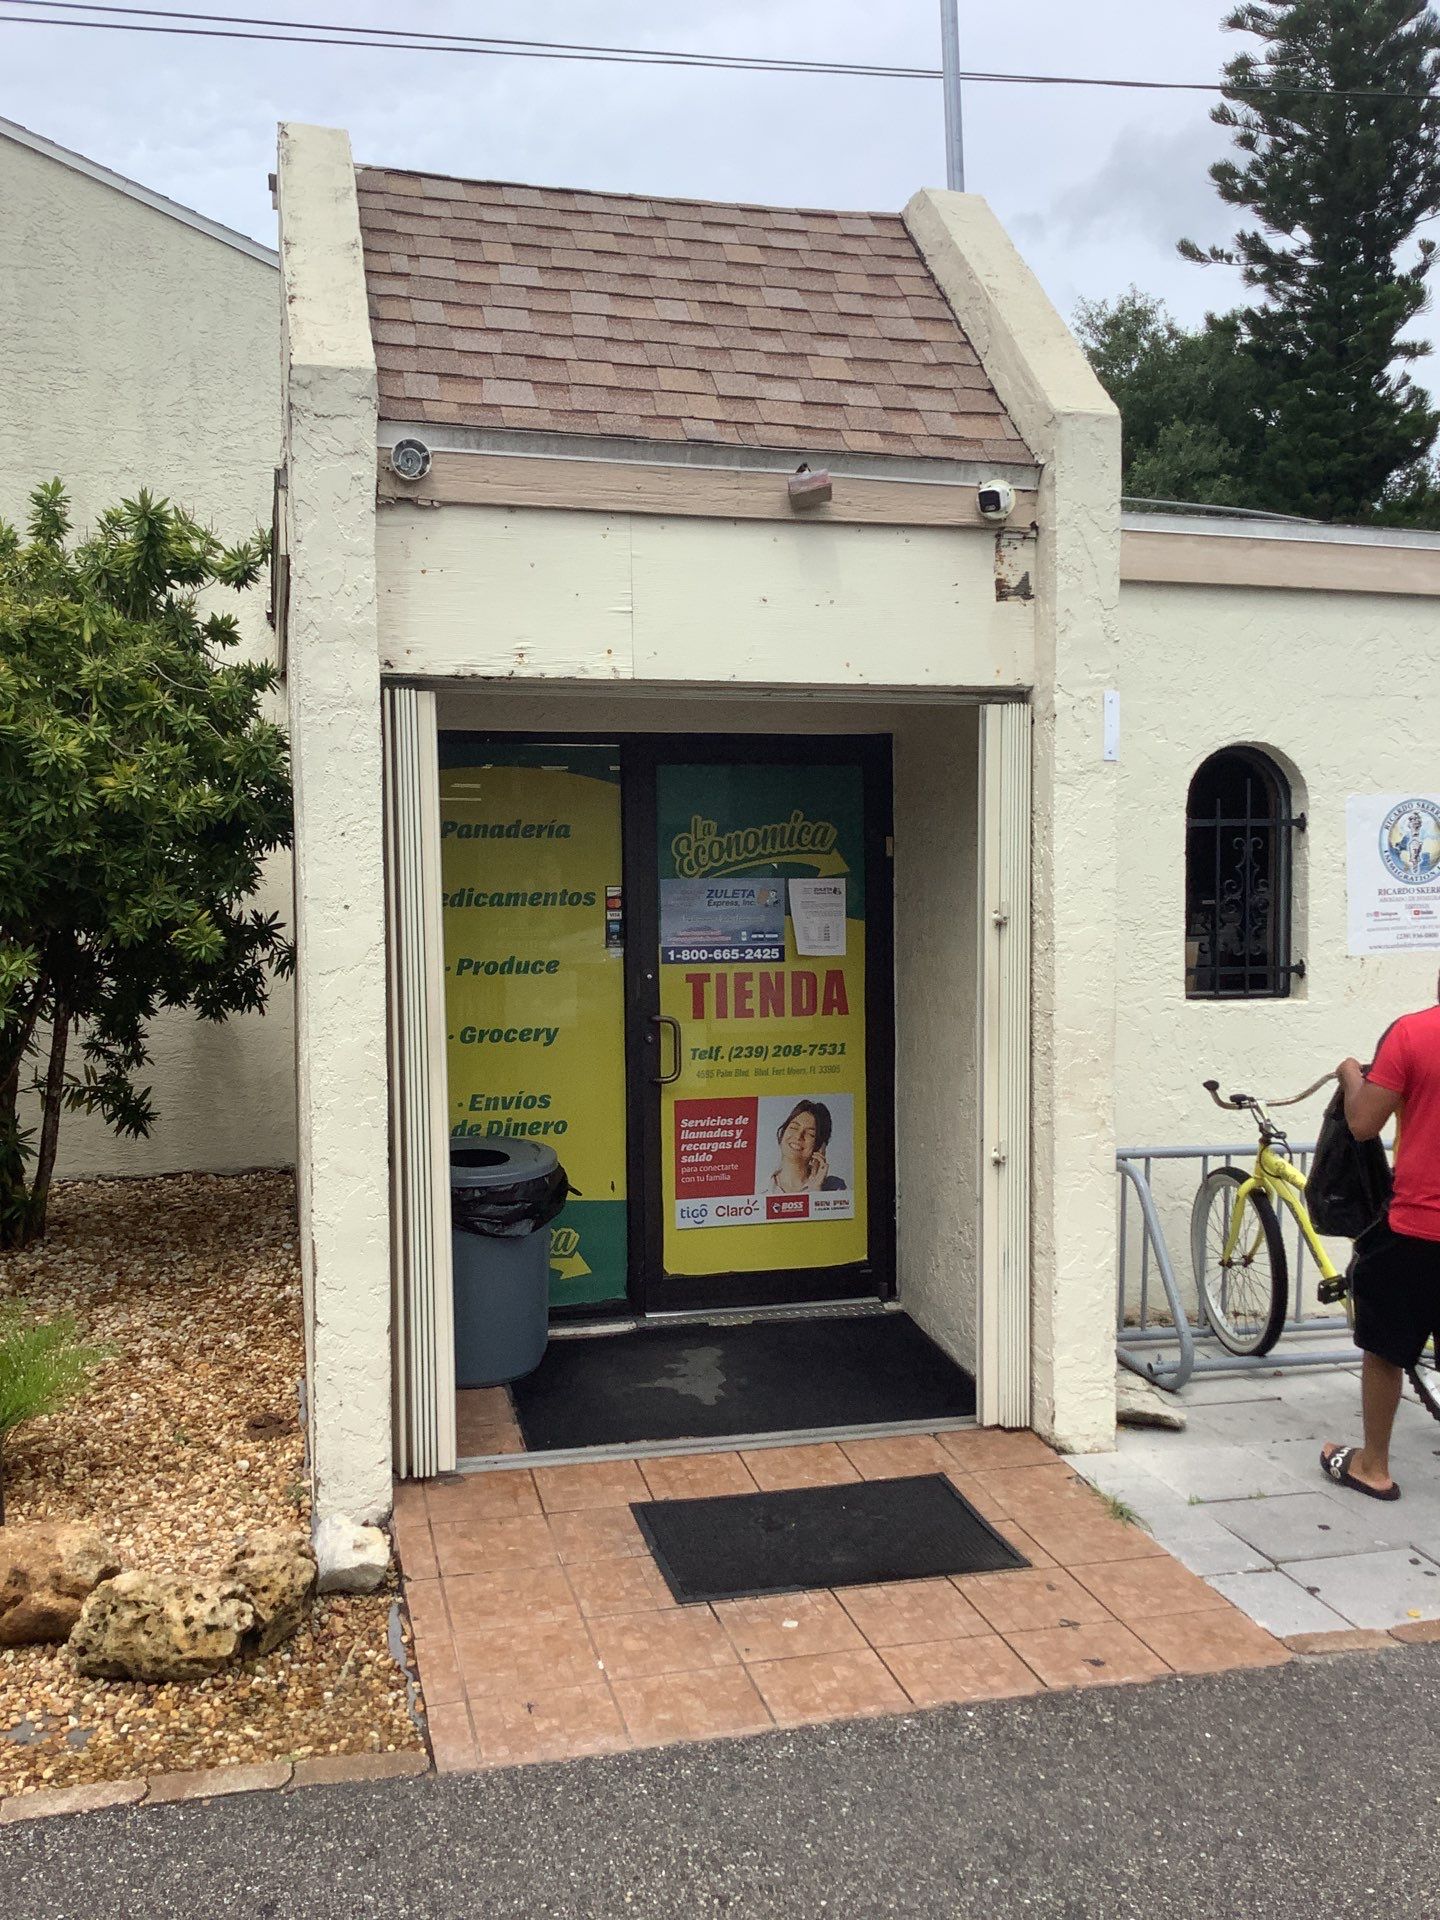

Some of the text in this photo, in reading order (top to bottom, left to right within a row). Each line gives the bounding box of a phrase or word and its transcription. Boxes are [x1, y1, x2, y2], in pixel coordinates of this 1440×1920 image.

[441, 819, 571, 839] Panadería
[672, 810, 837, 878] Economica
[1384, 849, 1435, 882] IMMIGRATION
[442, 887, 597, 908] edicamentos
[706, 889, 756, 899] ZULETA
[1378, 888, 1415, 896] RICARDO
[668, 948, 780, 961] 1-800-665-2425
[456, 955, 560, 976] Produce
[685, 969, 849, 1020] TIENDA
[460, 1026, 559, 1047] Grocery
[690, 1042, 847, 1062] Telf. (239) 208-7531
[469, 1090, 552, 1111] Envíos
[451, 1116, 568, 1138] de Dinero
[680, 1115, 749, 1127] Servicios de
[681, 1128, 743, 1139] llamadas y
[681, 1139, 748, 1152] recargas de
[681, 1152, 713, 1163] saldo
[681, 1163, 739, 1174] para conectarte
[706, 1173, 731, 1182] familia
[715, 1204, 753, 1217] Claro
